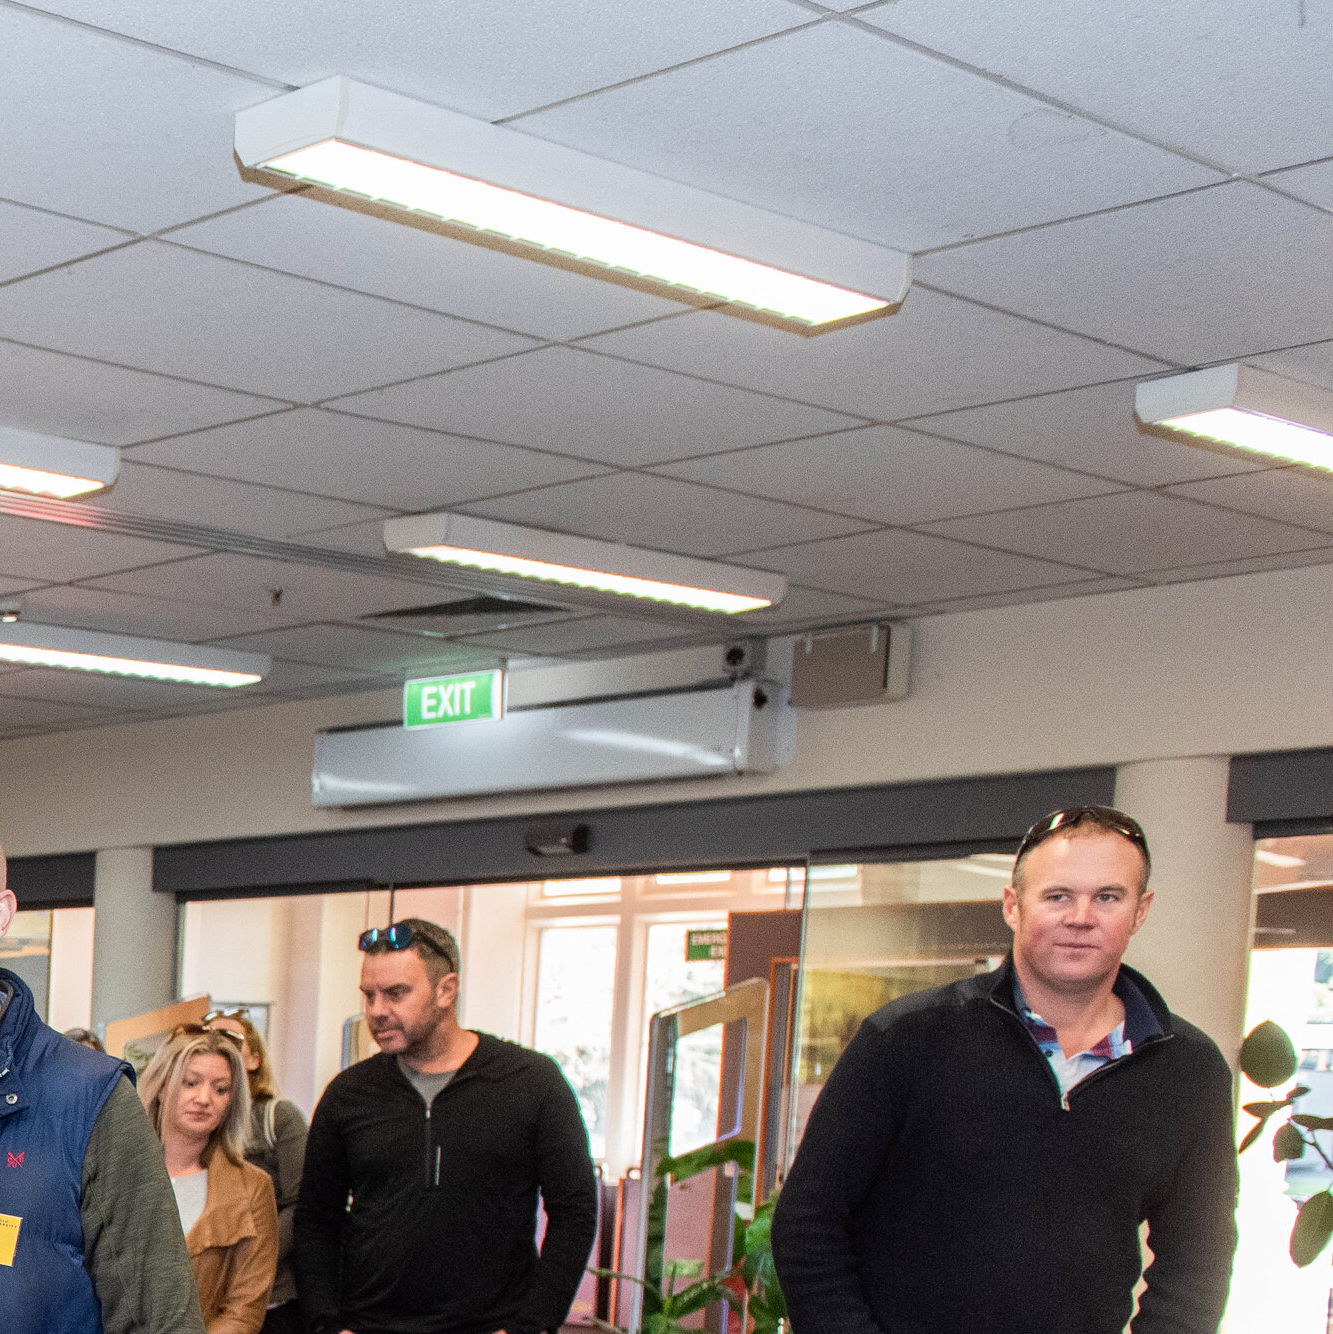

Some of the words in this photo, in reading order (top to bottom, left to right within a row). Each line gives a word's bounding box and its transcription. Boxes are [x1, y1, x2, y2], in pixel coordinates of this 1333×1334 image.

[421, 681, 476, 720] EXIT
[691, 932, 727, 946] EMERG
[710, 945, 727, 958] EX
